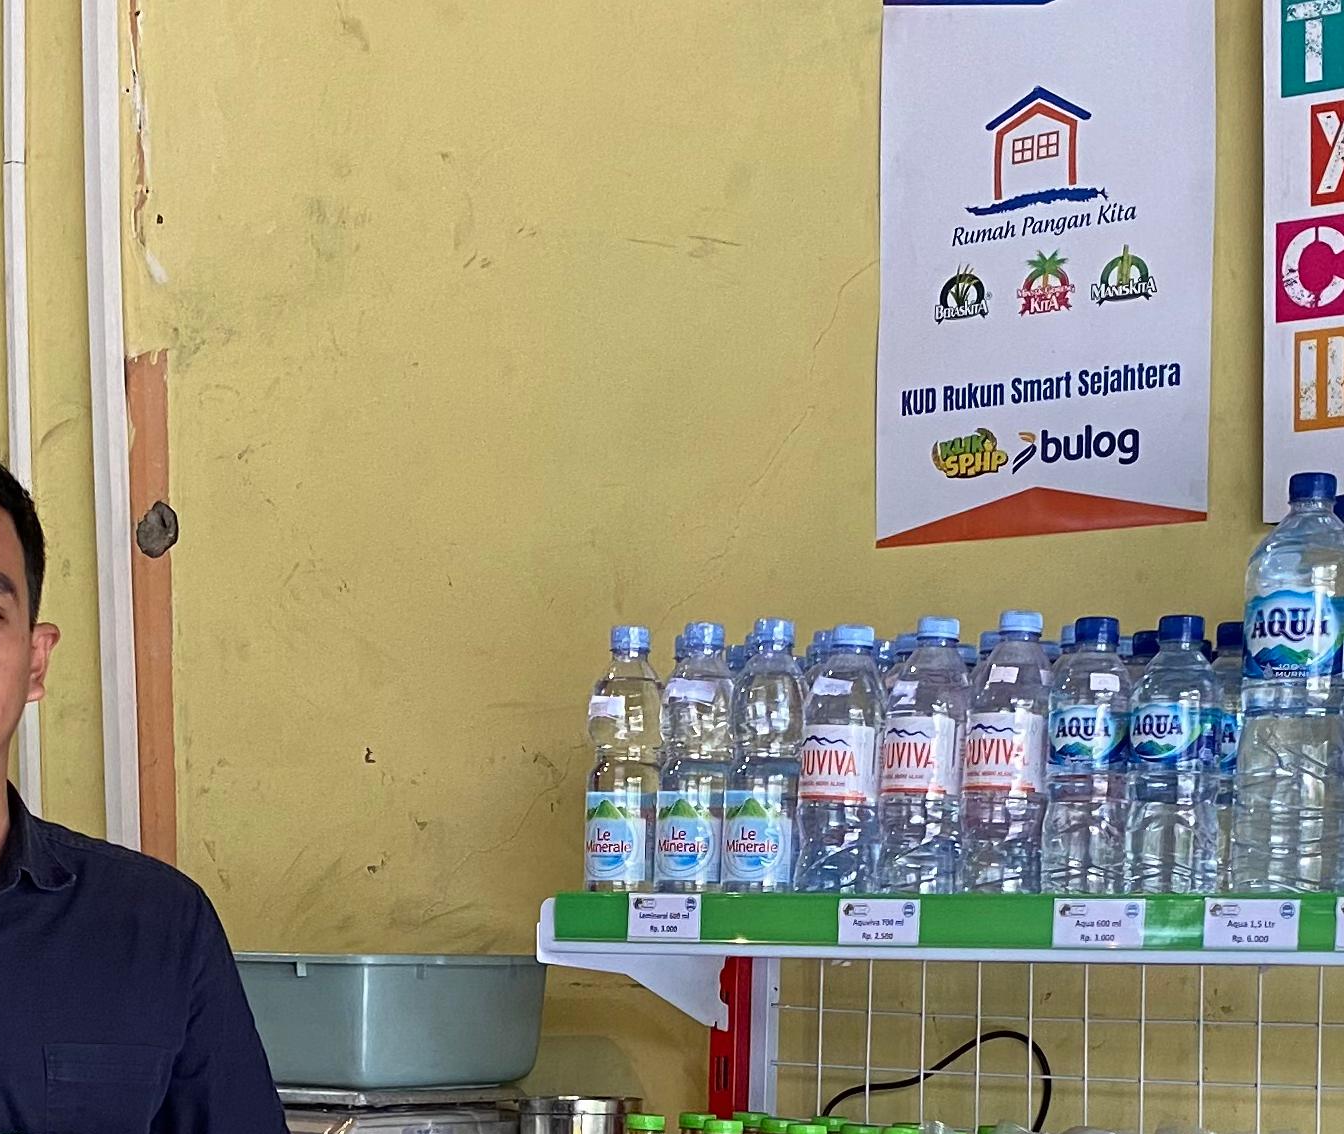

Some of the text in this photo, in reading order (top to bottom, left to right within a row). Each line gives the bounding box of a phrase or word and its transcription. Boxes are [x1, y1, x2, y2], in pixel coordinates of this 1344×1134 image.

[951, 203, 1136, 247] Rumah Pangan Kita
[901, 362, 1181, 416] KUD Rukun Smart Sejahtera
[1041, 424, 1140, 465] bulog
[945, 450, 1008, 477] SPHP
[1251, 607, 1329, 639] AQUA
[1056, 717, 1111, 741] AQUA
[1132, 714, 1184, 738] AQUA
[597, 827, 611, 841] Le
[672, 826, 686, 840] Le
[740, 827, 757, 841] Le
[586, 841, 633, 853] Minerale
[658, 840, 709, 852] Minerale
[726, 840, 778, 852] Minerale
